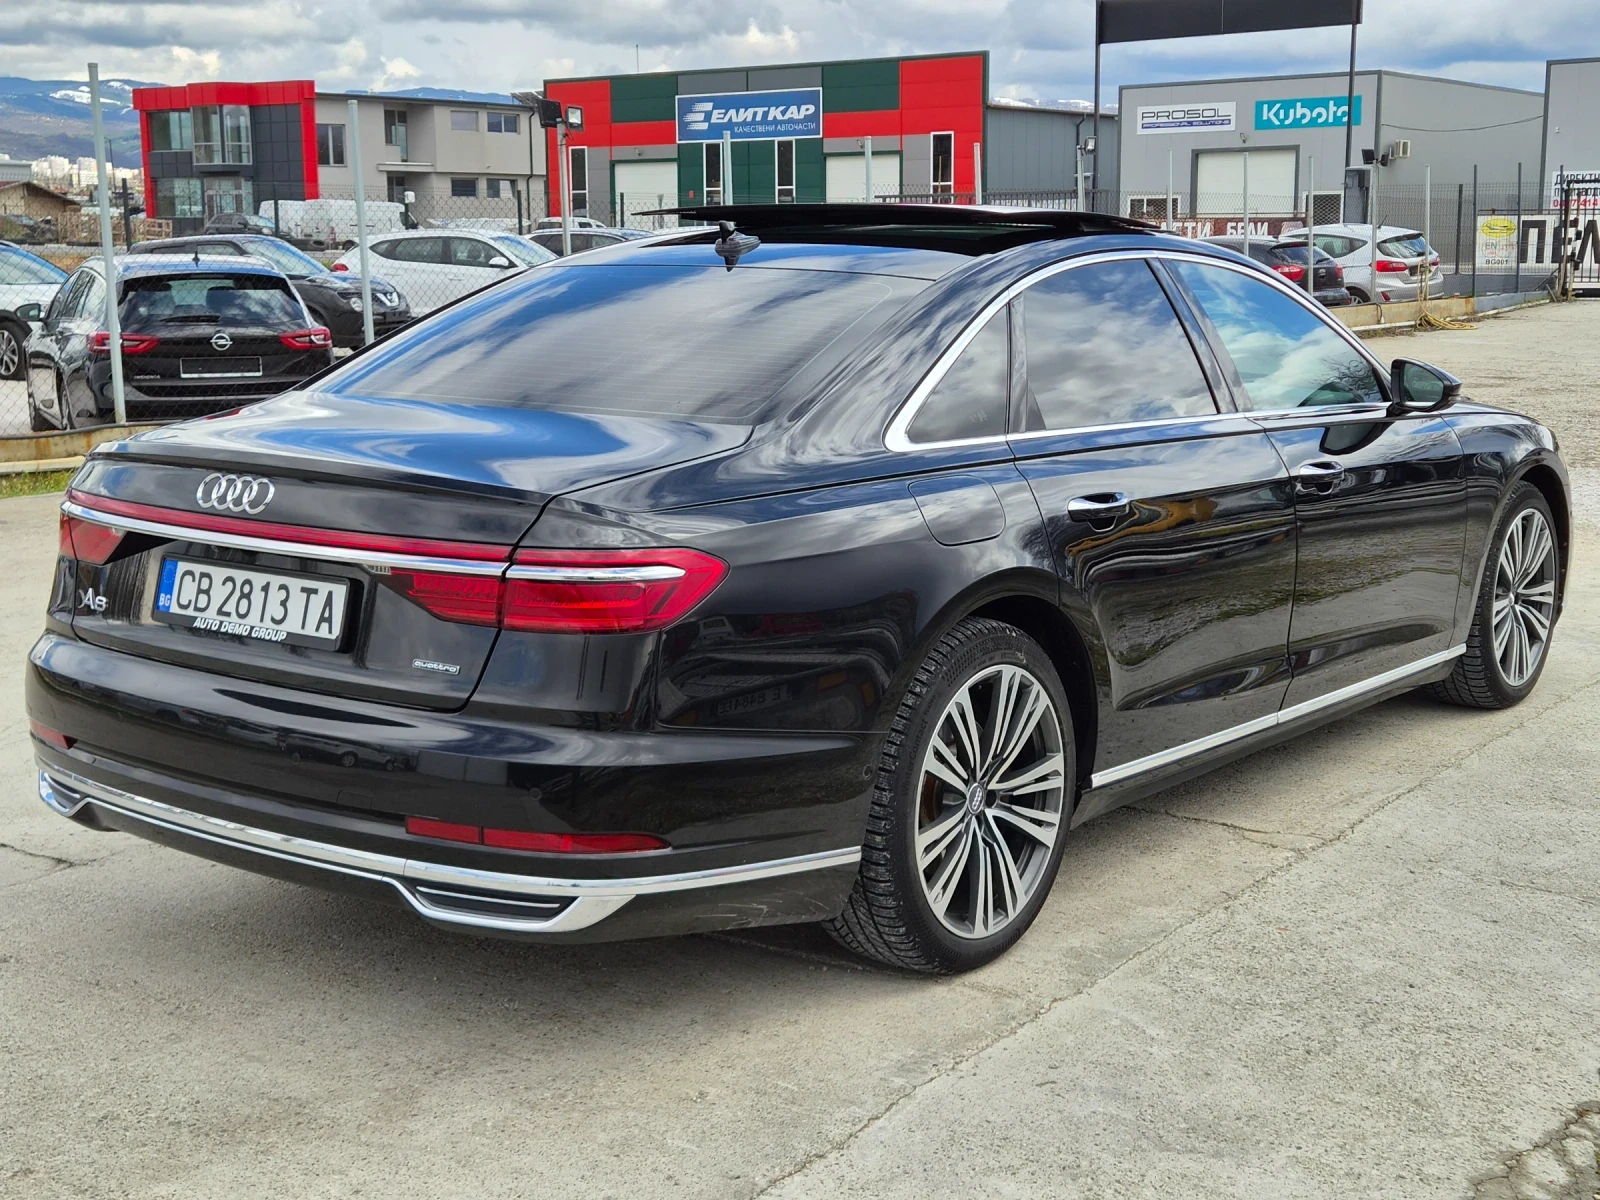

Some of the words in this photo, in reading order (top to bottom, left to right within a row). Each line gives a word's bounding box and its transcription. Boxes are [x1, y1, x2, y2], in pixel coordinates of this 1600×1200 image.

[1141, 107, 1232, 121] PROSOL
[1262, 100, 1349, 125] Kubota
[734, 125, 775, 133] КАЧЕСТВЕНИ
[777, 122, 816, 131] АВТОЧАСТИ
[84, 587, 107, 611] A8
[159, 593, 171, 606] BG
[176, 569, 213, 613] CB
[216, 575, 291, 626] 2813
[300, 586, 333, 635] TA
[193, 616, 219, 631] AUTO
[220, 621, 250, 637] DEMO
[251, 626, 287, 642] GROUP
[414, 660, 457, 673] quattro
